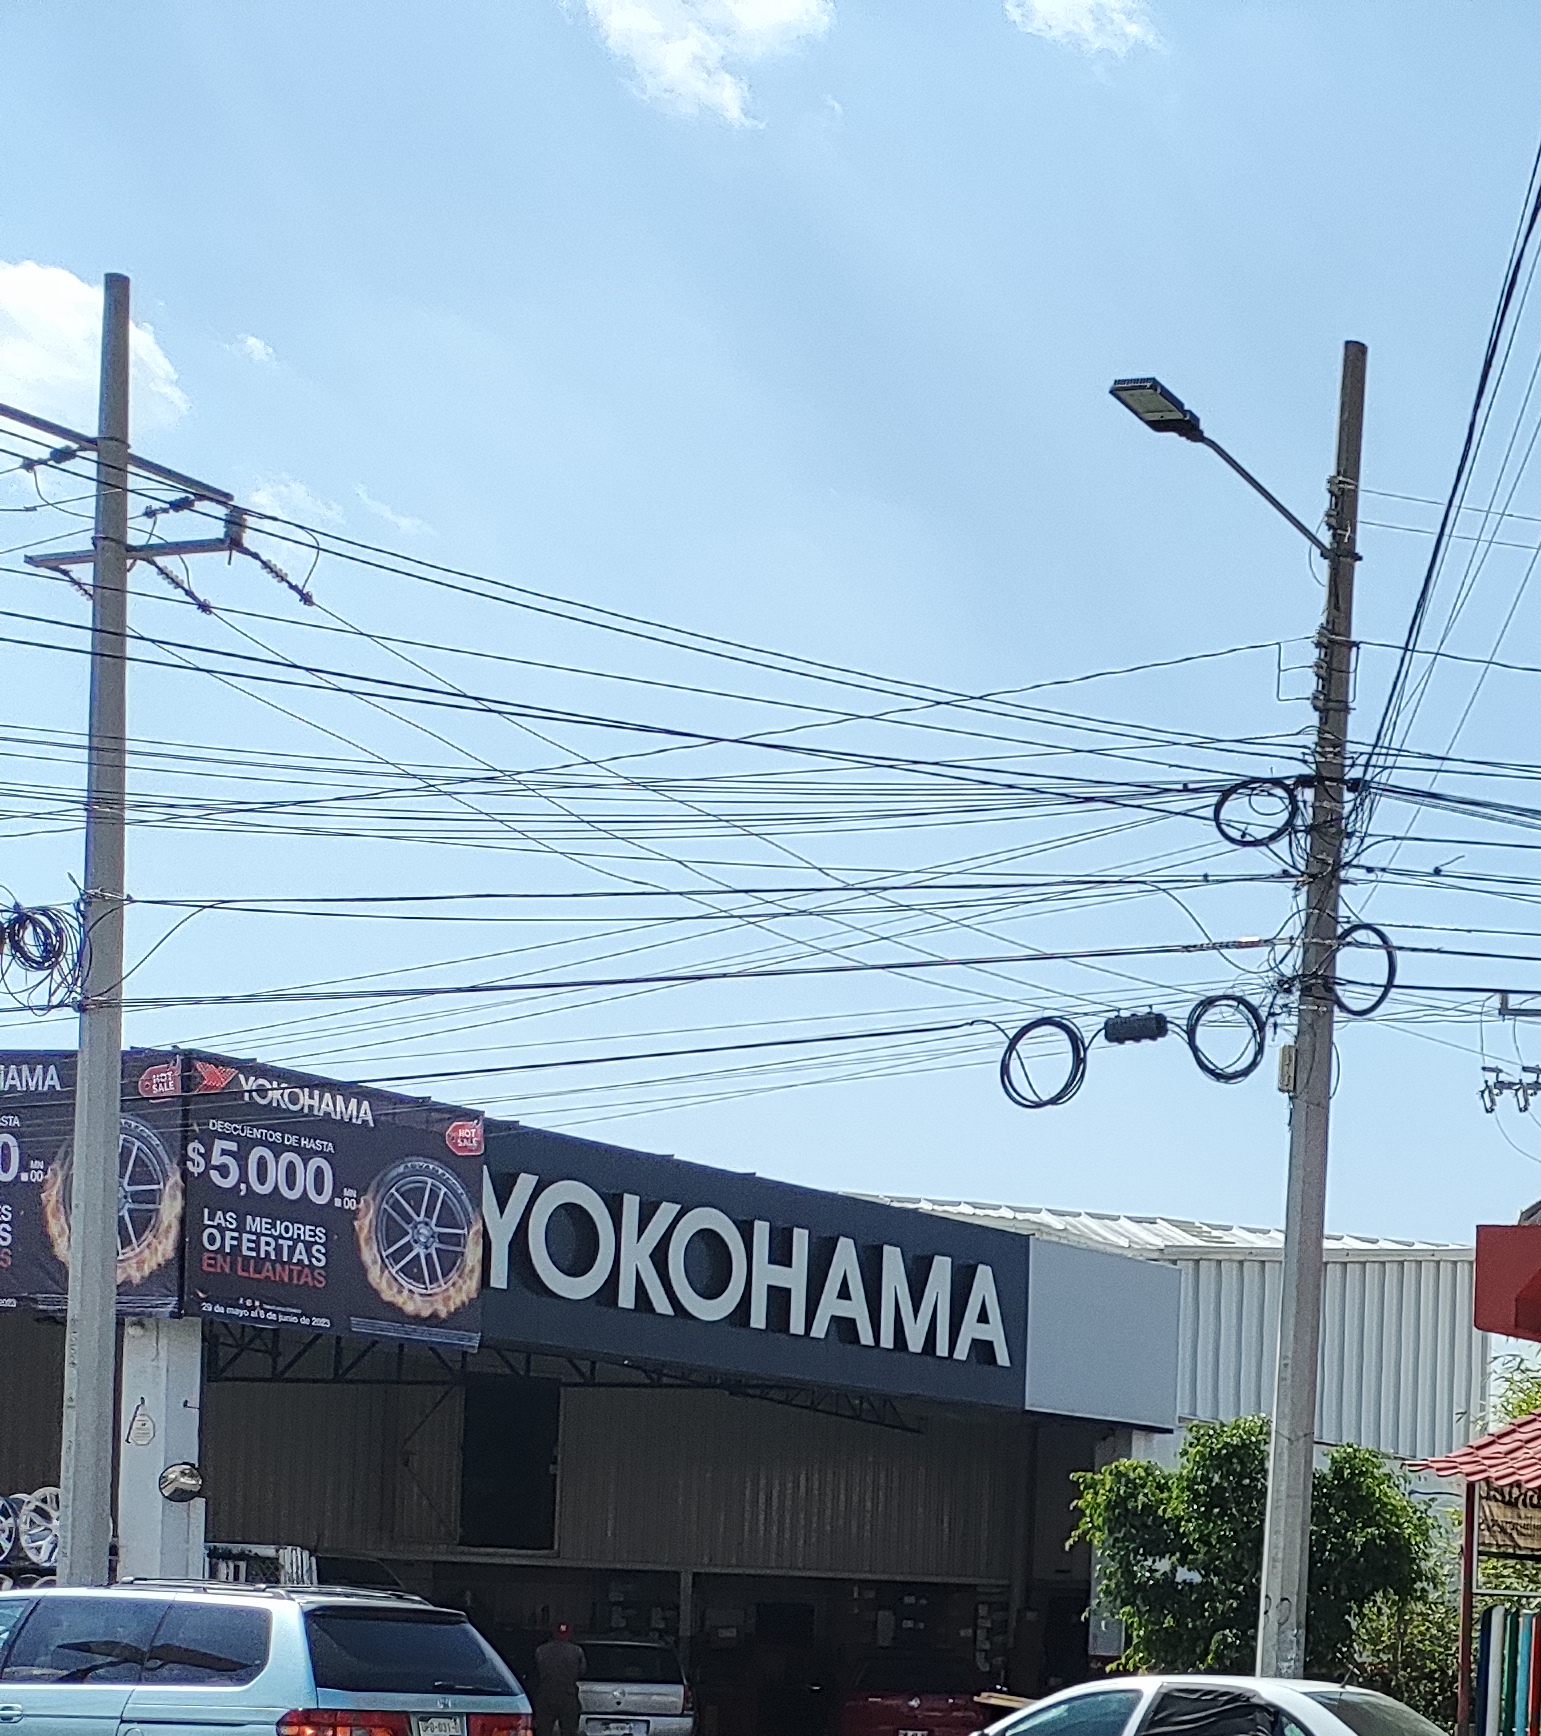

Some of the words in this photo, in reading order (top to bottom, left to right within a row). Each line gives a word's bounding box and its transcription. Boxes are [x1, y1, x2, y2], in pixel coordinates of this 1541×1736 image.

[152, 1071, 173, 1083] HOT
[152, 1081, 175, 1094] SALE
[238, 1074, 375, 1127] YOKOHAMA
[209, 1119, 283, 1144] DESCUENTOS
[284, 1133, 299, 1147] DE
[301, 1136, 336, 1154] HASTA
[457, 1138, 478, 1148] SALE
[458, 1128, 477, 1138] HOT
[203, 1207, 238, 1229] LAS
[246, 1214, 327, 1244] MEJORES
[202, 1227, 327, 1268] OFERTAS
[202, 1253, 230, 1273] EN
[237, 1256, 327, 1288] LLANTAS
[483, 1165, 1011, 1368] YOKOHAMA
[226, 1307, 249, 1318] mayo
[278, 1312, 299, 1323] junio
